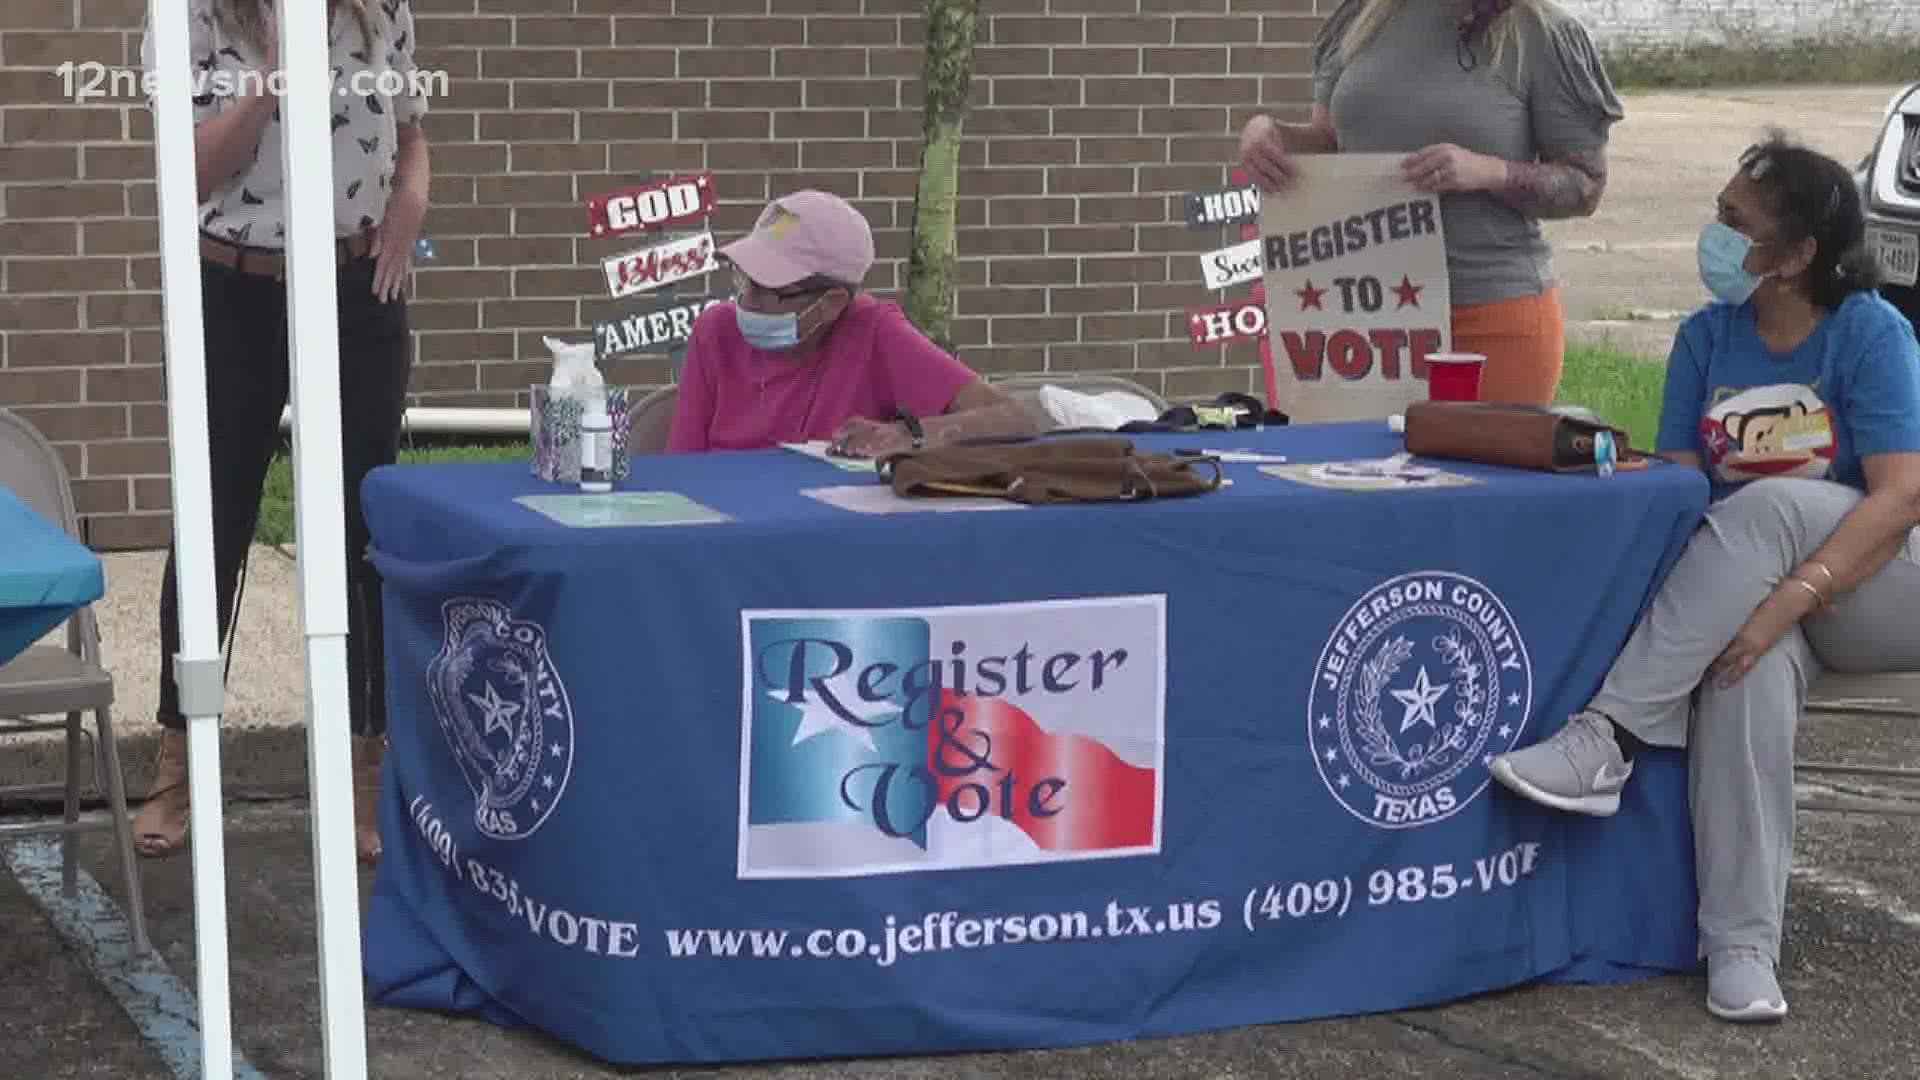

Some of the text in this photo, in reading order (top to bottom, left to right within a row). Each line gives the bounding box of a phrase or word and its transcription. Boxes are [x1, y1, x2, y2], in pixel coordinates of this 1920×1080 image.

[606, 183, 700, 230] GOD
[1265, 200, 1436, 271] REGISTER
[1200, 305, 1265, 342] HO
[1334, 275, 1383, 313] TO
[1280, 329, 1442, 381] VOTE
[1323, 580, 1522, 691] JEFFERSON COUNTY
[758, 638, 1128, 732] Register
[934, 706, 999, 776] &
[839, 762, 1067, 848] Vote
[1373, 786, 1457, 823] TEXAS
[664, 898, 1222, 967] www.co.jefferson.tx.us
[1243, 875, 1353, 932] (409)
